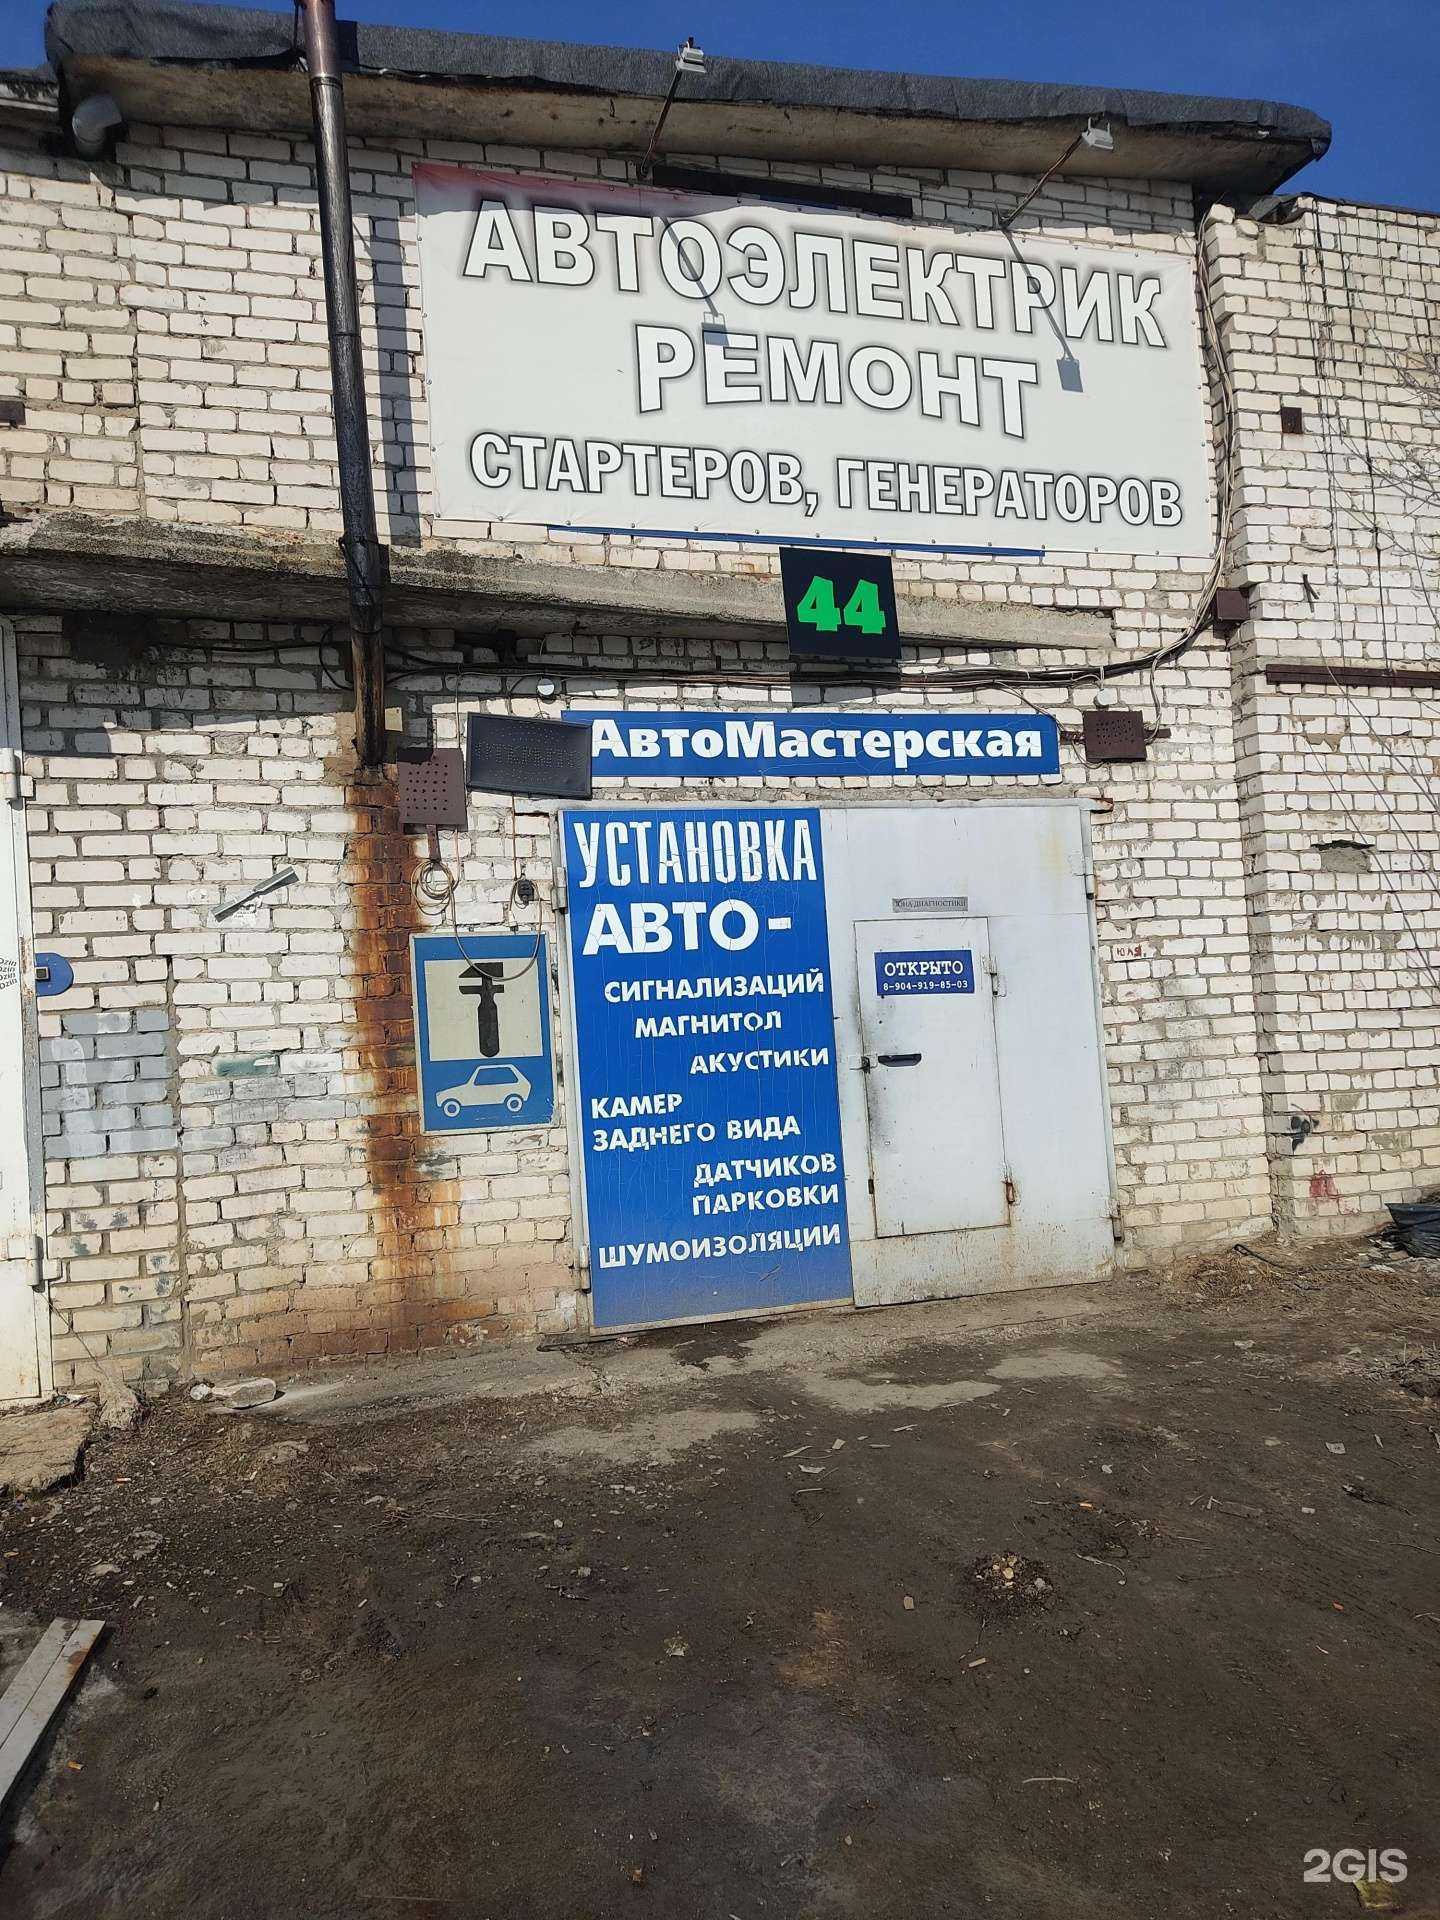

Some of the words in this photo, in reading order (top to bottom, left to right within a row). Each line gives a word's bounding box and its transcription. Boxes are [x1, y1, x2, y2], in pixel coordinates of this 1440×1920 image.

[462, 199, 1167, 348] АВТОЭЛЕКТРИК
[635, 323, 1038, 439] РЕМОНТ
[470, 432, 818, 517] СТАРТЕРОВ,
[836, 457, 1183, 527] ГЕНЕРАТОРОВ
[796, 575, 887, 635] 44
[591, 719, 1042, 768] АвтоМастерская
[573, 818, 817, 888] УСТАНОВКА
[583, 898, 792, 955] АВТО-
[605, 968, 825, 1003] СИГНАЛИЗАЦИЙ
[883, 980, 968, 991] 8-904-919-85-03
[884, 961, 963, 976] ОТКРЫТО
[634, 1010, 782, 1039] МАГНИТОЛ
[689, 1048, 829, 1075] АКУСТИКИ
[591, 1093, 683, 1119] КАМЕР
[592, 1122, 715, 1152] ЗАДНЕГО
[726, 1115, 800, 1141] ВИДА
[694, 1153, 837, 1187] ДАТЧИКОВ
[692, 1184, 839, 1216] ПАРКОВКИ
[598, 1224, 840, 1269] ШУМОИЗОЛЯЦИИ
